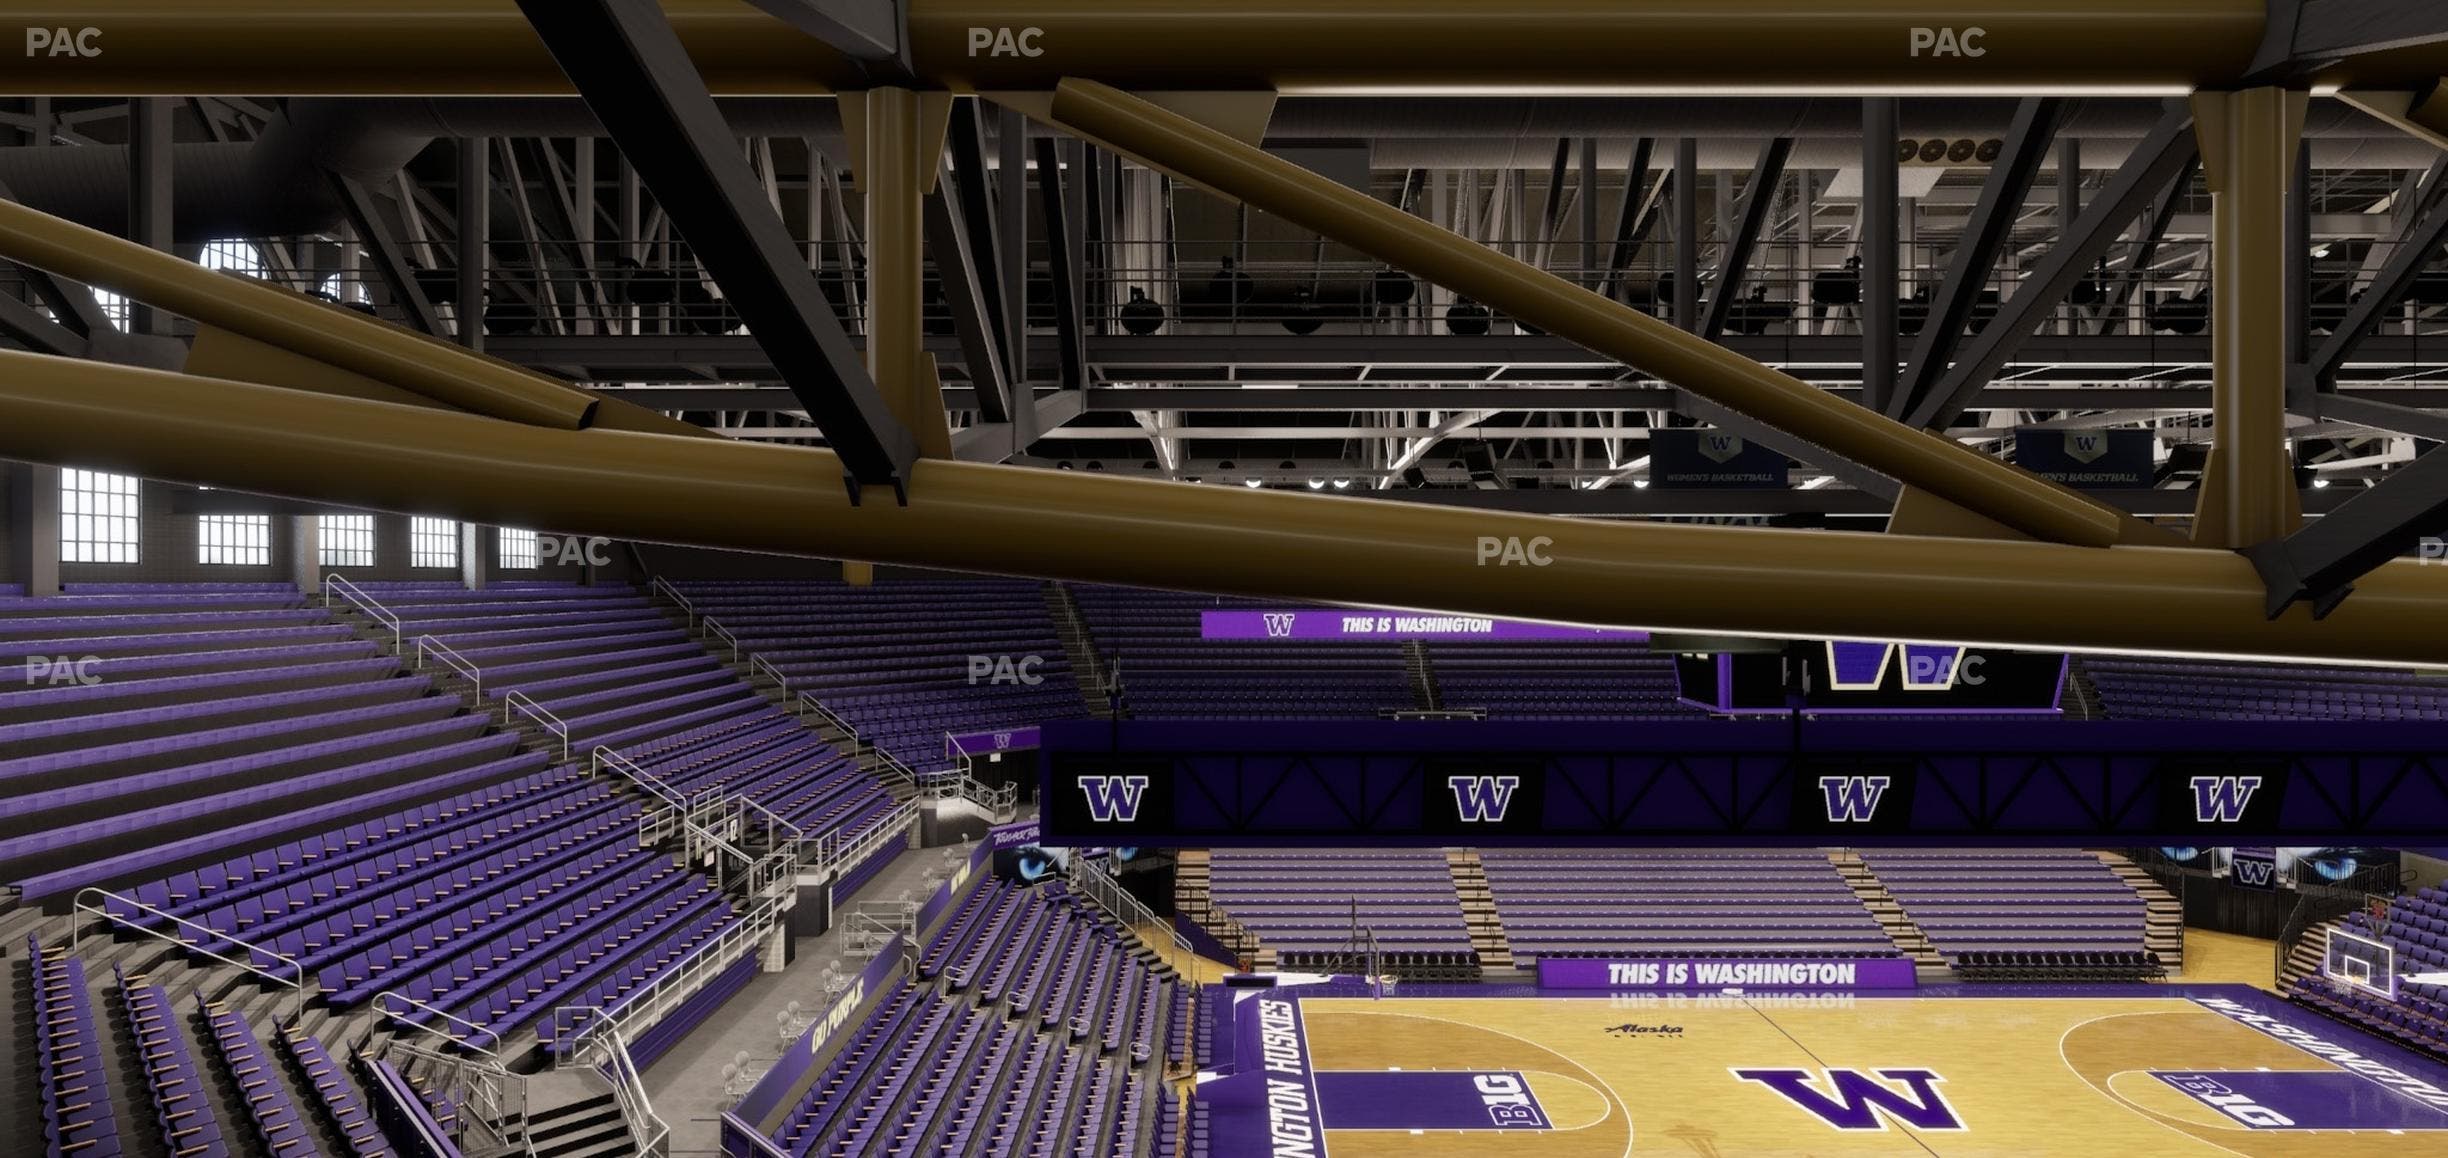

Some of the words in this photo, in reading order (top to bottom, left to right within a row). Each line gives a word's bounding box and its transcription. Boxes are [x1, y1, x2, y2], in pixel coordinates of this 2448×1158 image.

[1667, 473, 1709, 482] WOMEN'S
[1711, 473, 1774, 482] BASKETBALL
[2068, 472, 2139, 482] BASKETBALL
[1343, 617, 1374, 633] THIS
[1376, 617, 1391, 633] IS
[1395, 617, 1493, 633] WASHINGTON
[1078, 776, 1149, 822] W
[1448, 776, 1519, 822] W
[1819, 776, 1890, 822] W
[2190, 776, 2261, 822] W
[2233, 858, 2274, 886] W
[1608, 963, 1659, 984] THIS
[1666, 963, 1689, 984] IS
[1695, 963, 1855, 984] WASHINGTON
[1259, 1000, 1303, 1076] HUSKIES
[1604, 1023, 1684, 1034] Alaska
[1726, 1067, 1971, 1132] W
